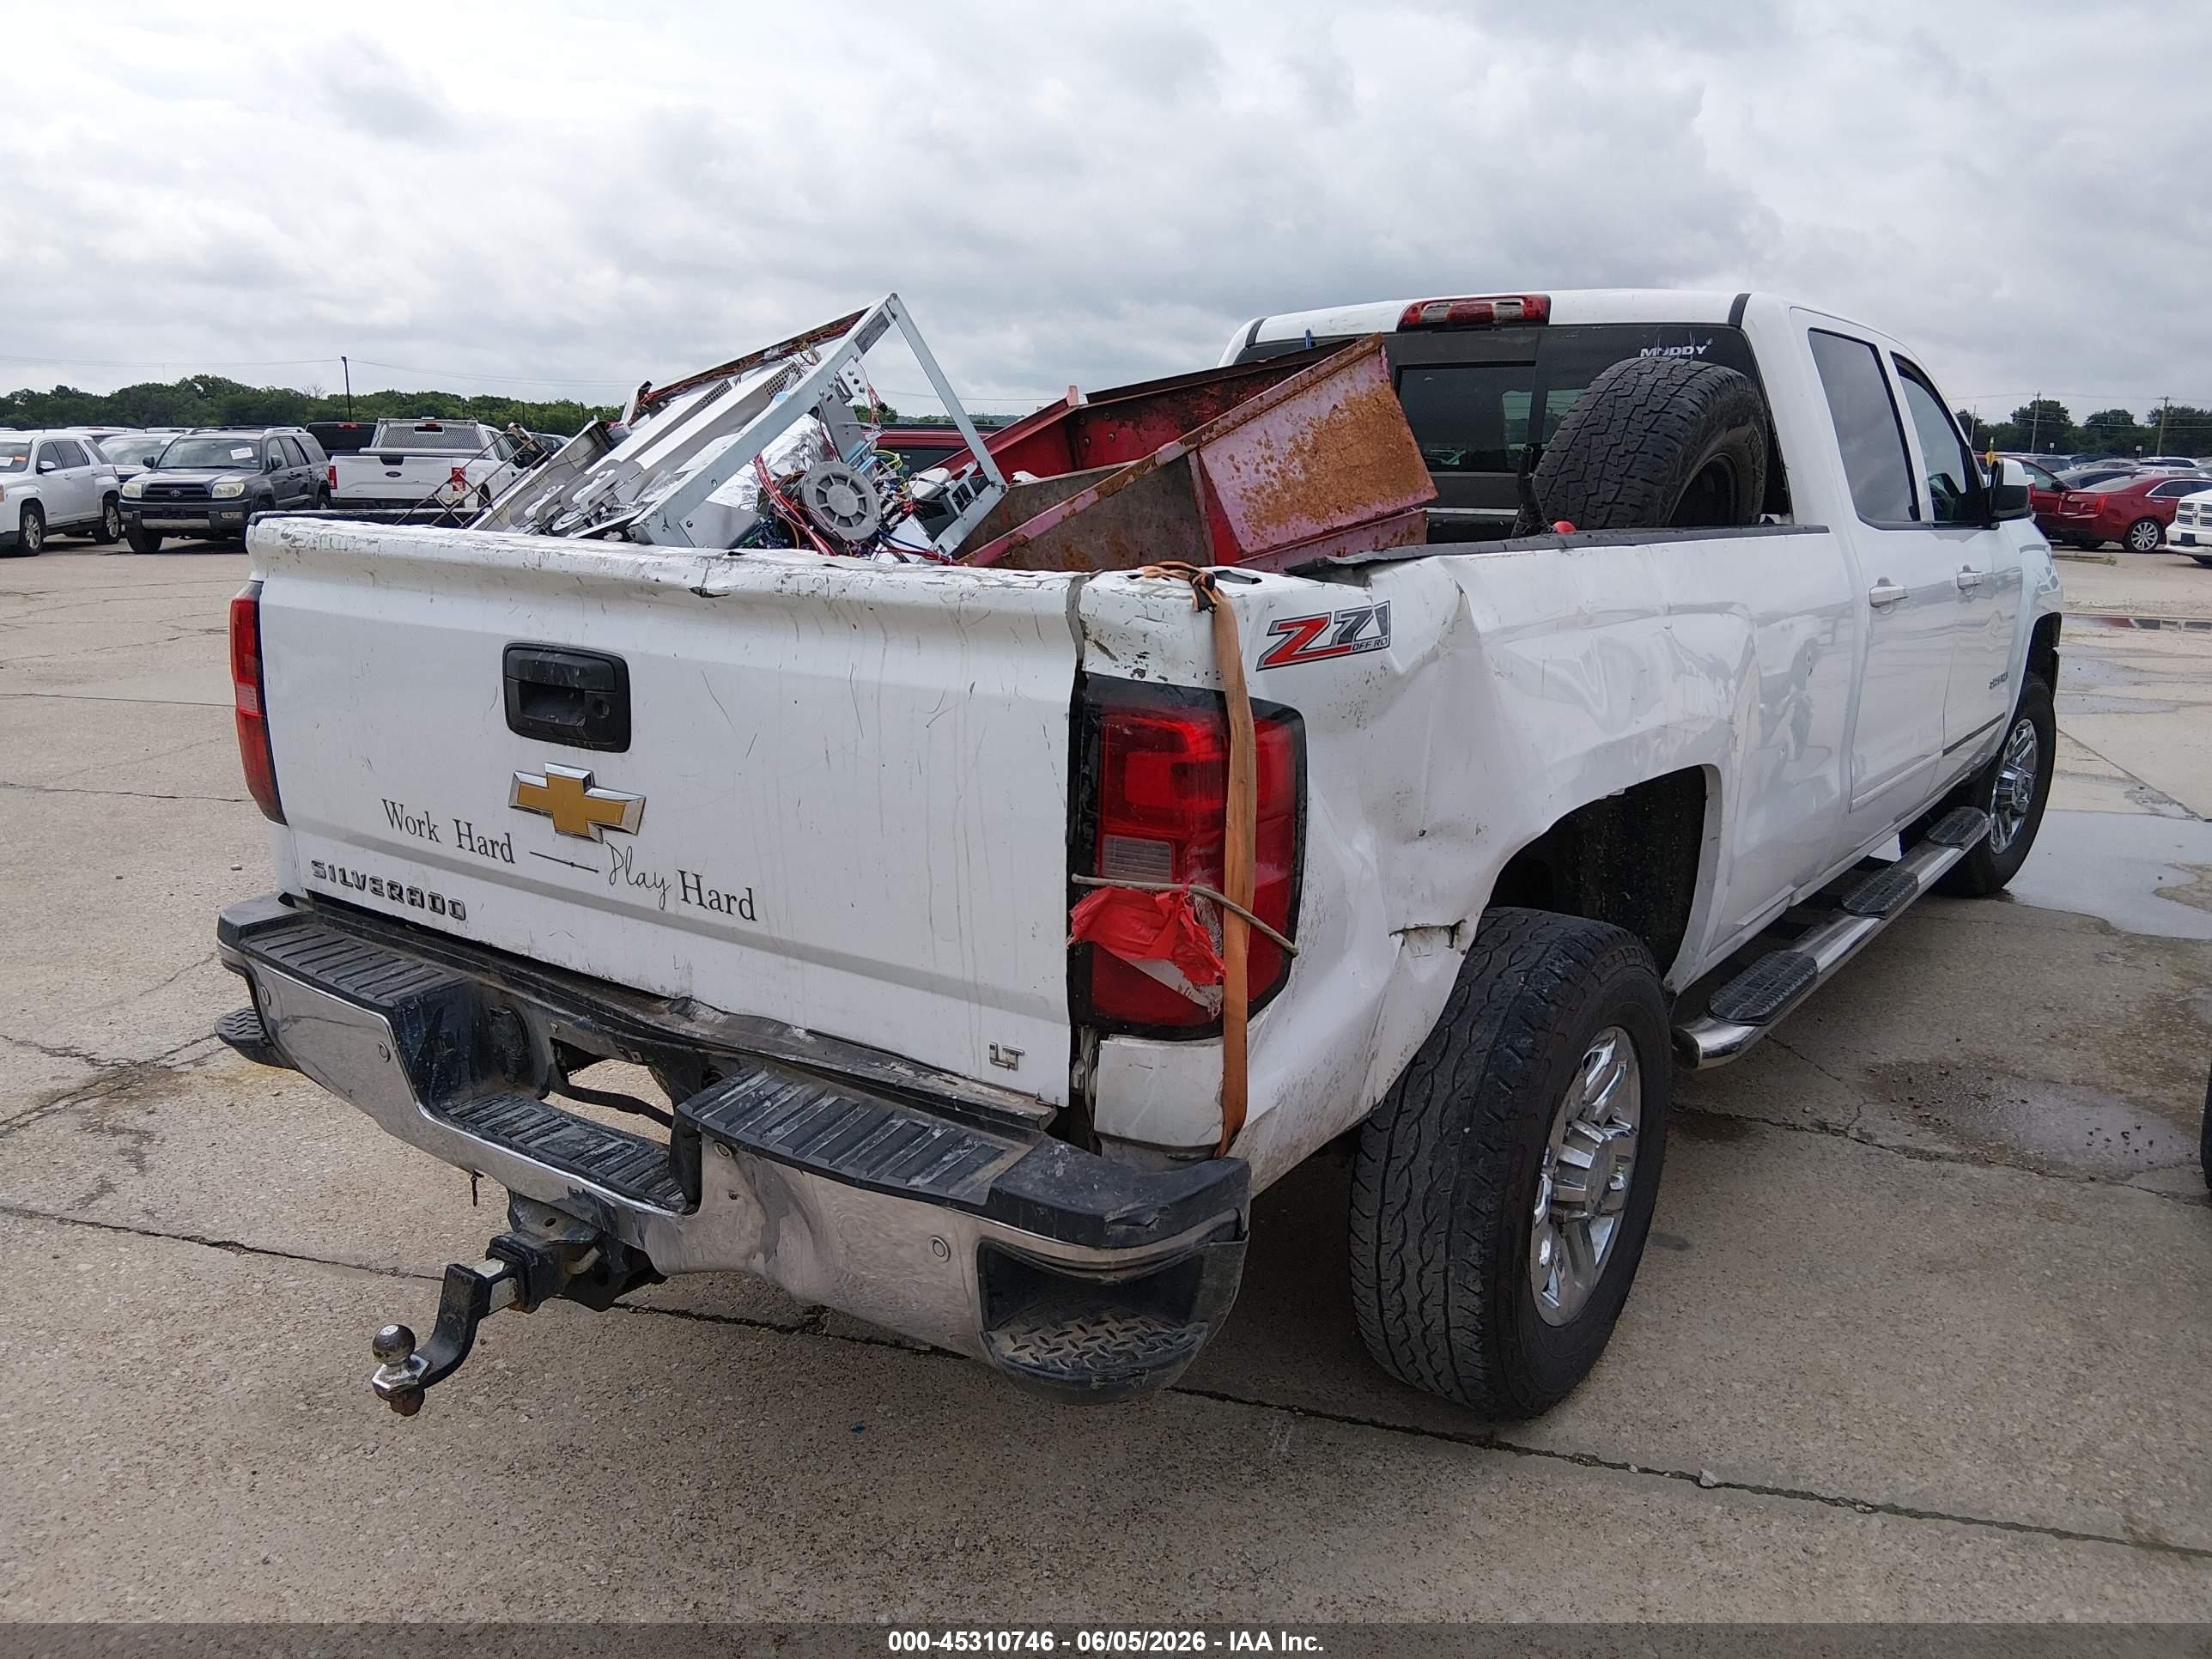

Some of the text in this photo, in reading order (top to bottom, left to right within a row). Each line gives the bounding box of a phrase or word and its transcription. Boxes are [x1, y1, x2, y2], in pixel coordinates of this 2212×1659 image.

[1352, 641, 1372, 651] OFF
[382, 799, 757, 921] Work Hard Play Hard
[311, 860, 466, 921] SILVERADO
[989, 1042, 1024, 1071] LT
